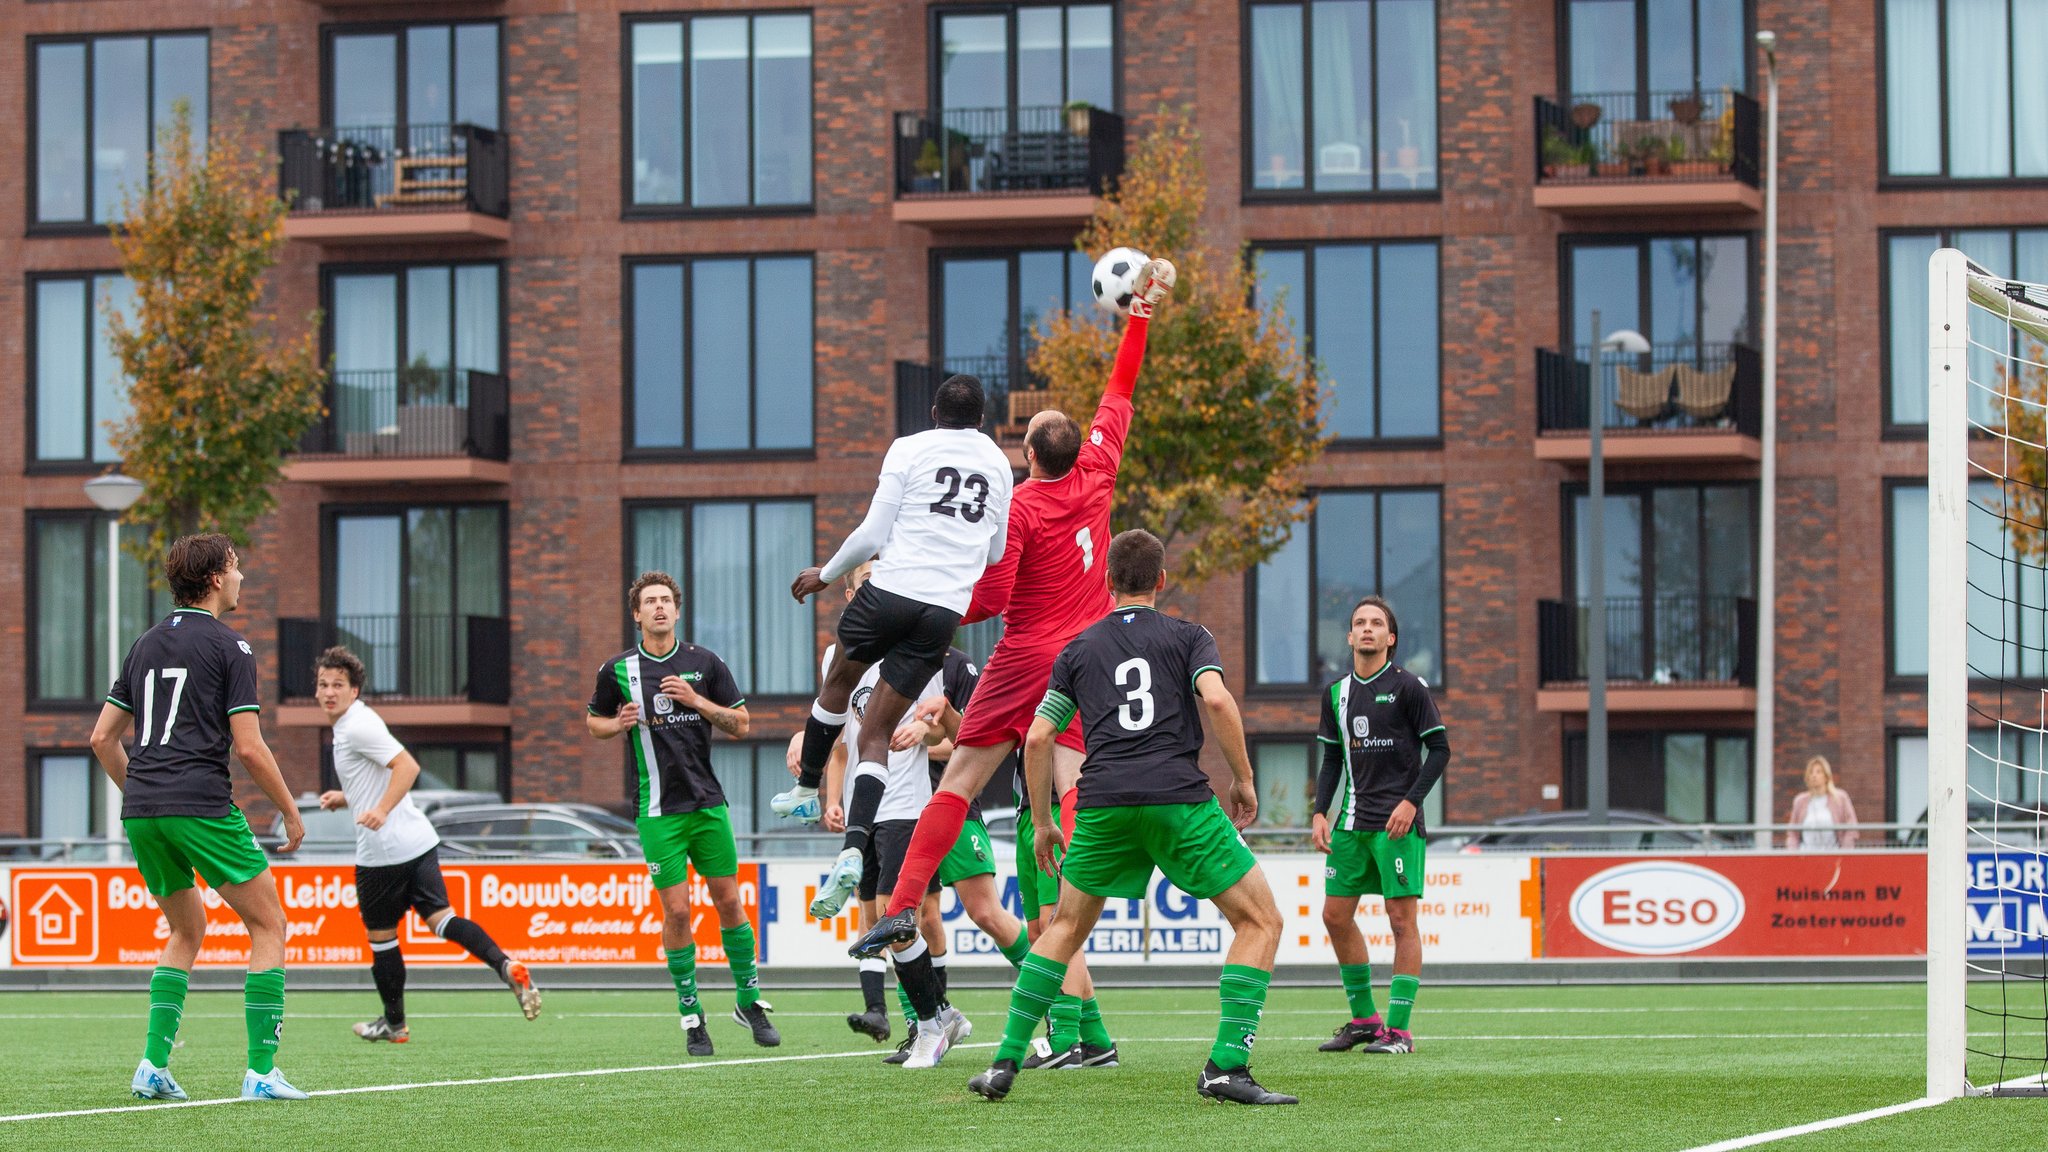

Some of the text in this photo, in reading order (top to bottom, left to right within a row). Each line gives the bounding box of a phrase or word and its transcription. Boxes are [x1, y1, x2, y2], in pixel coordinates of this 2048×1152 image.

[930, 467, 989, 523] 23
[1075, 526, 1094, 574] 1
[1115, 657, 1155, 731] 3
[140, 667, 188, 747] 17
[651, 716, 664, 726] As
[667, 713, 701, 723] Oviron
[1351, 737, 1394, 748] As Oviron
[971, 835, 982, 851] 2
[1395, 857, 1404, 874] 9
[284, 875, 359, 909] Leide
[480, 873, 655, 916] Bouwbedrijf
[1776, 886, 1902, 901] Huisman BV
[1453, 903, 1490, 917] (ZH)
[1771, 913, 1906, 928] Zoeterwoude
[527, 911, 568, 938] Een
[570, 917, 635, 935] niveau
